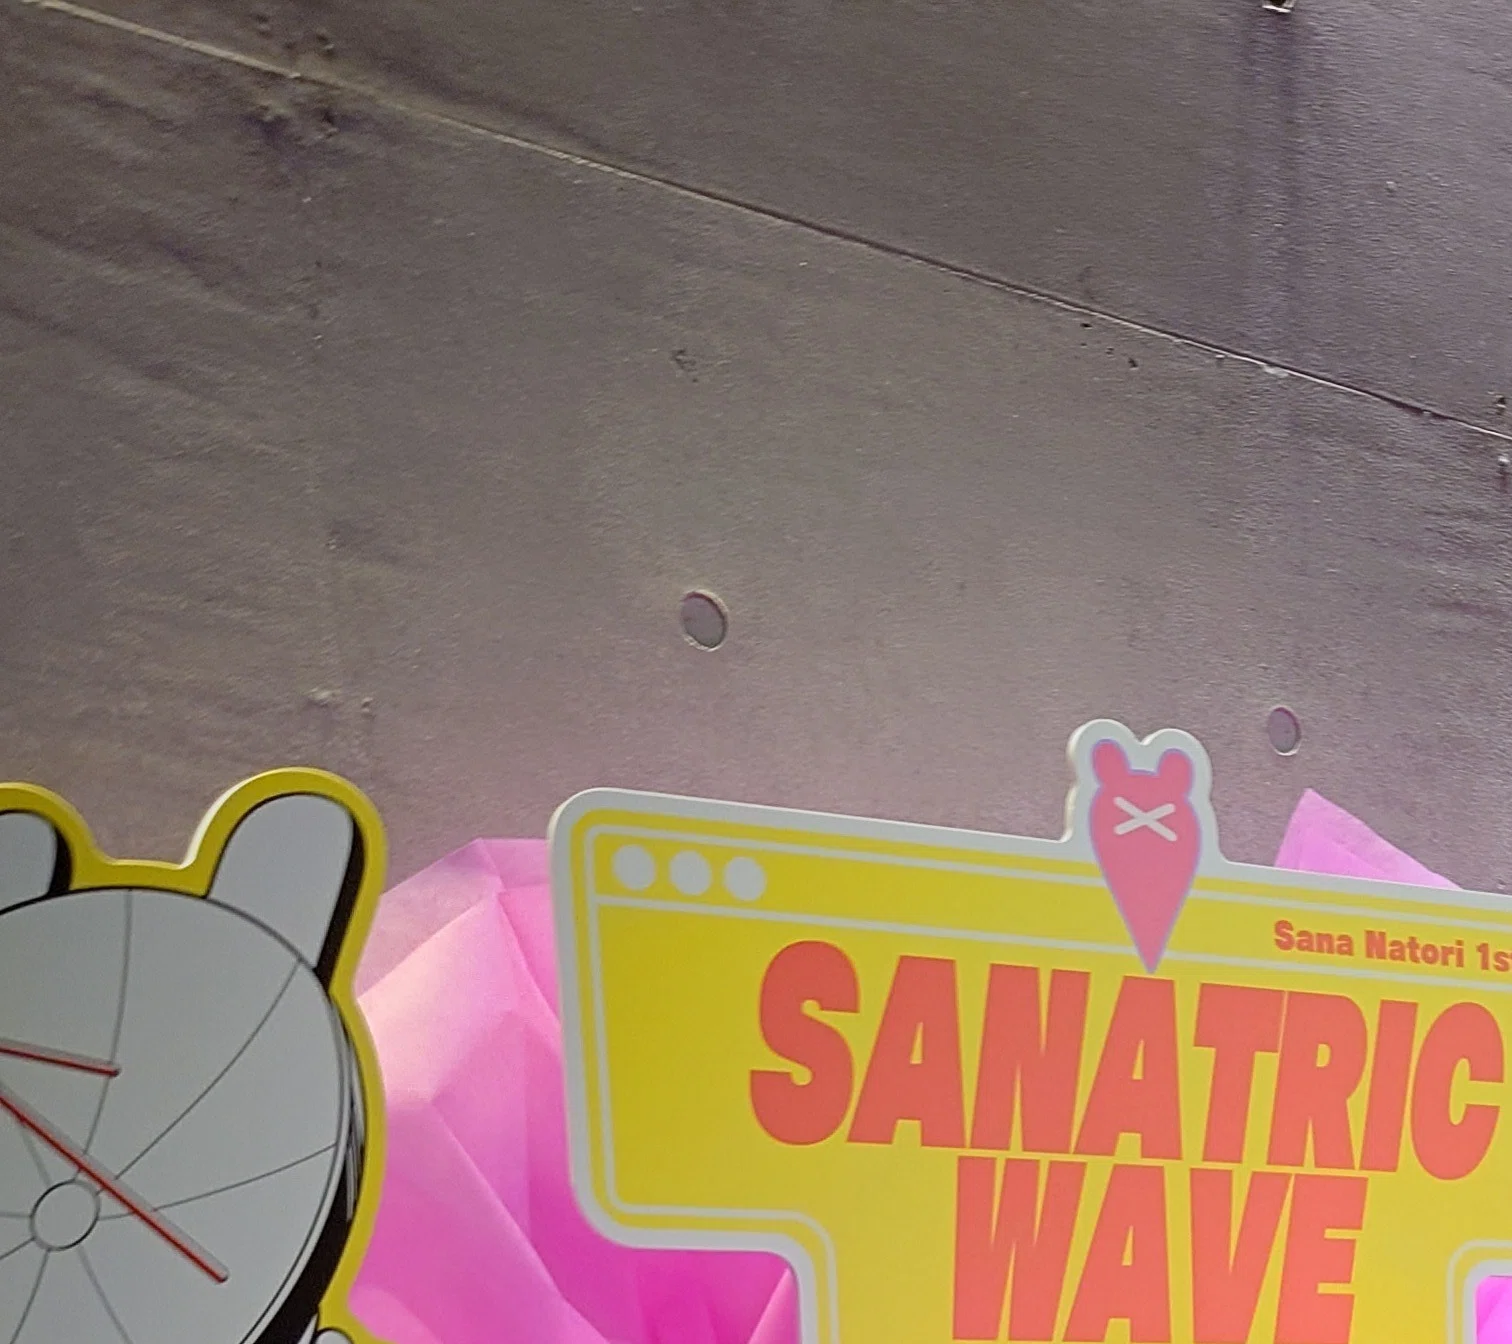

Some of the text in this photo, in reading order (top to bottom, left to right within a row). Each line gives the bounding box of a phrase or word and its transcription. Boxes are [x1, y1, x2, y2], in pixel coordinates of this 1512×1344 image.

[1273, 920, 1355, 957] Sana
[1364, 930, 1464, 968] Natori
[749, 940, 1505, 1181] SANATRIC
